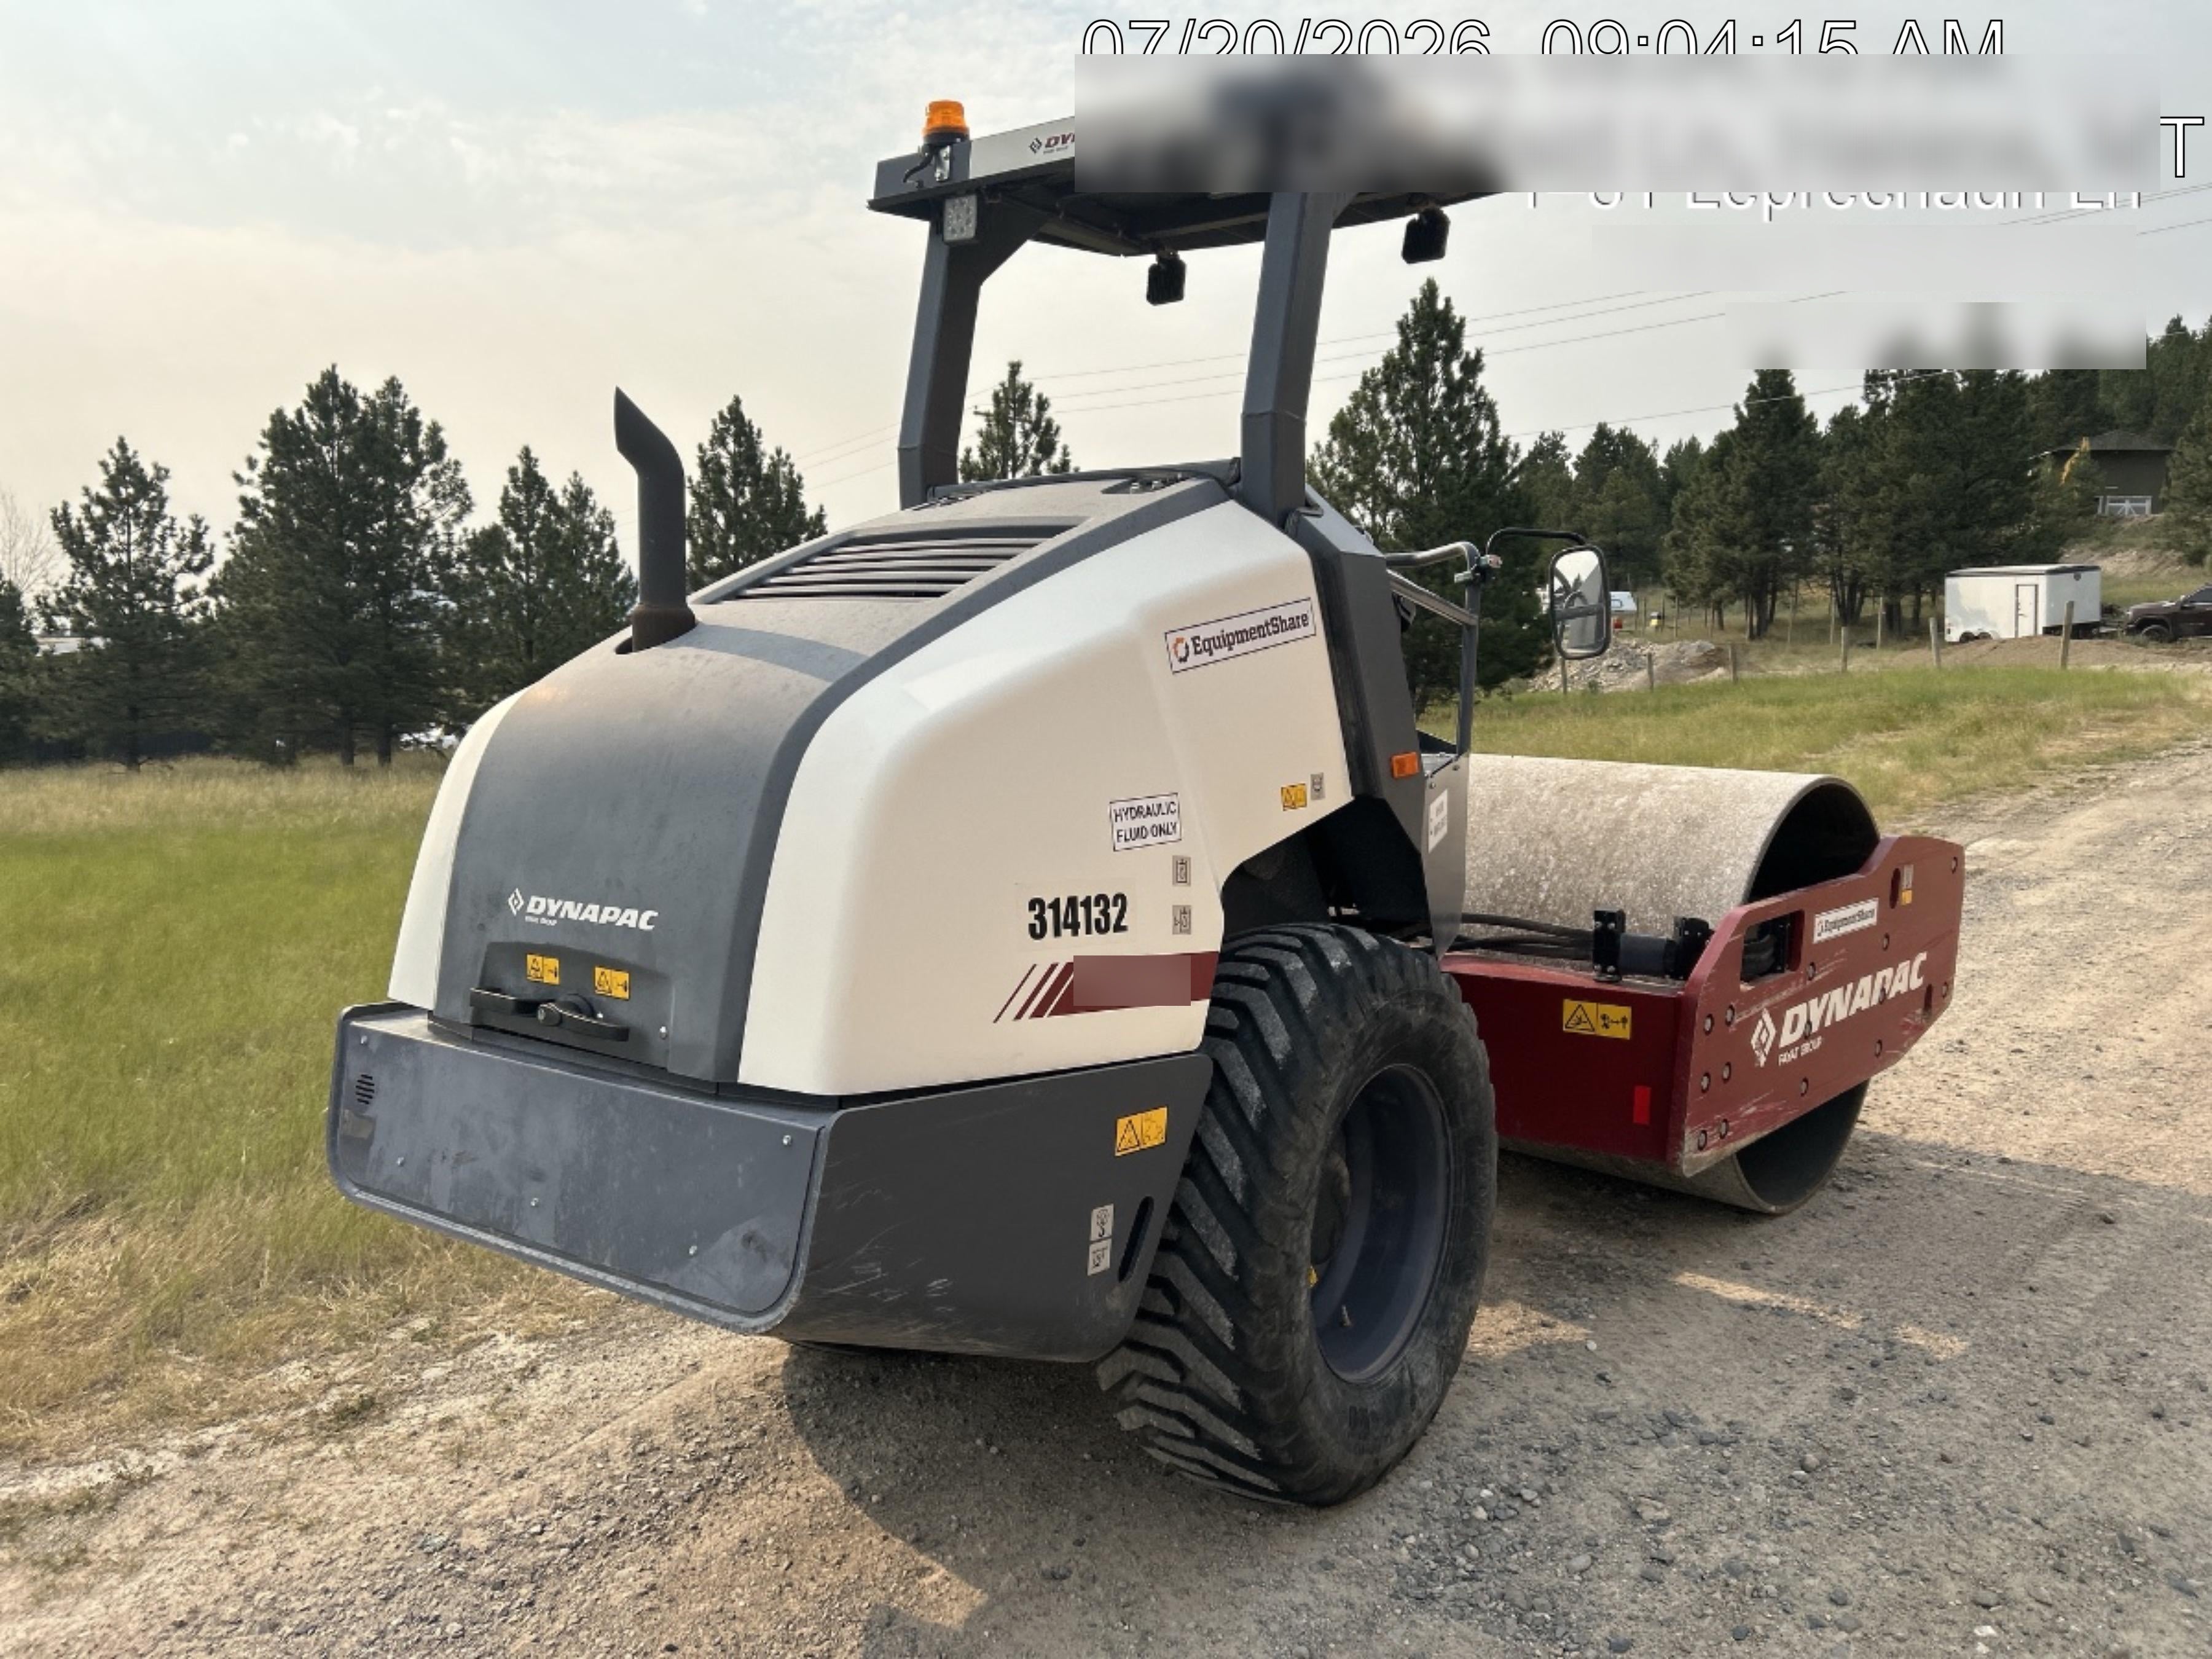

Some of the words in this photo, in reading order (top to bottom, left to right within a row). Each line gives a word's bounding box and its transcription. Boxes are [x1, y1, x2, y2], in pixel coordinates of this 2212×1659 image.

[1191, 612, 1309, 656] EquipmentShare
[1113, 801, 1176, 823] HYDRAULIC
[1116, 825, 1148, 842] FLUID
[1151, 822, 1177, 837] ONLY
[525, 895, 659, 930] DYNAPAC
[1028, 892, 1129, 941] 314132
[1779, 951, 1928, 1048] DYNAPAC
